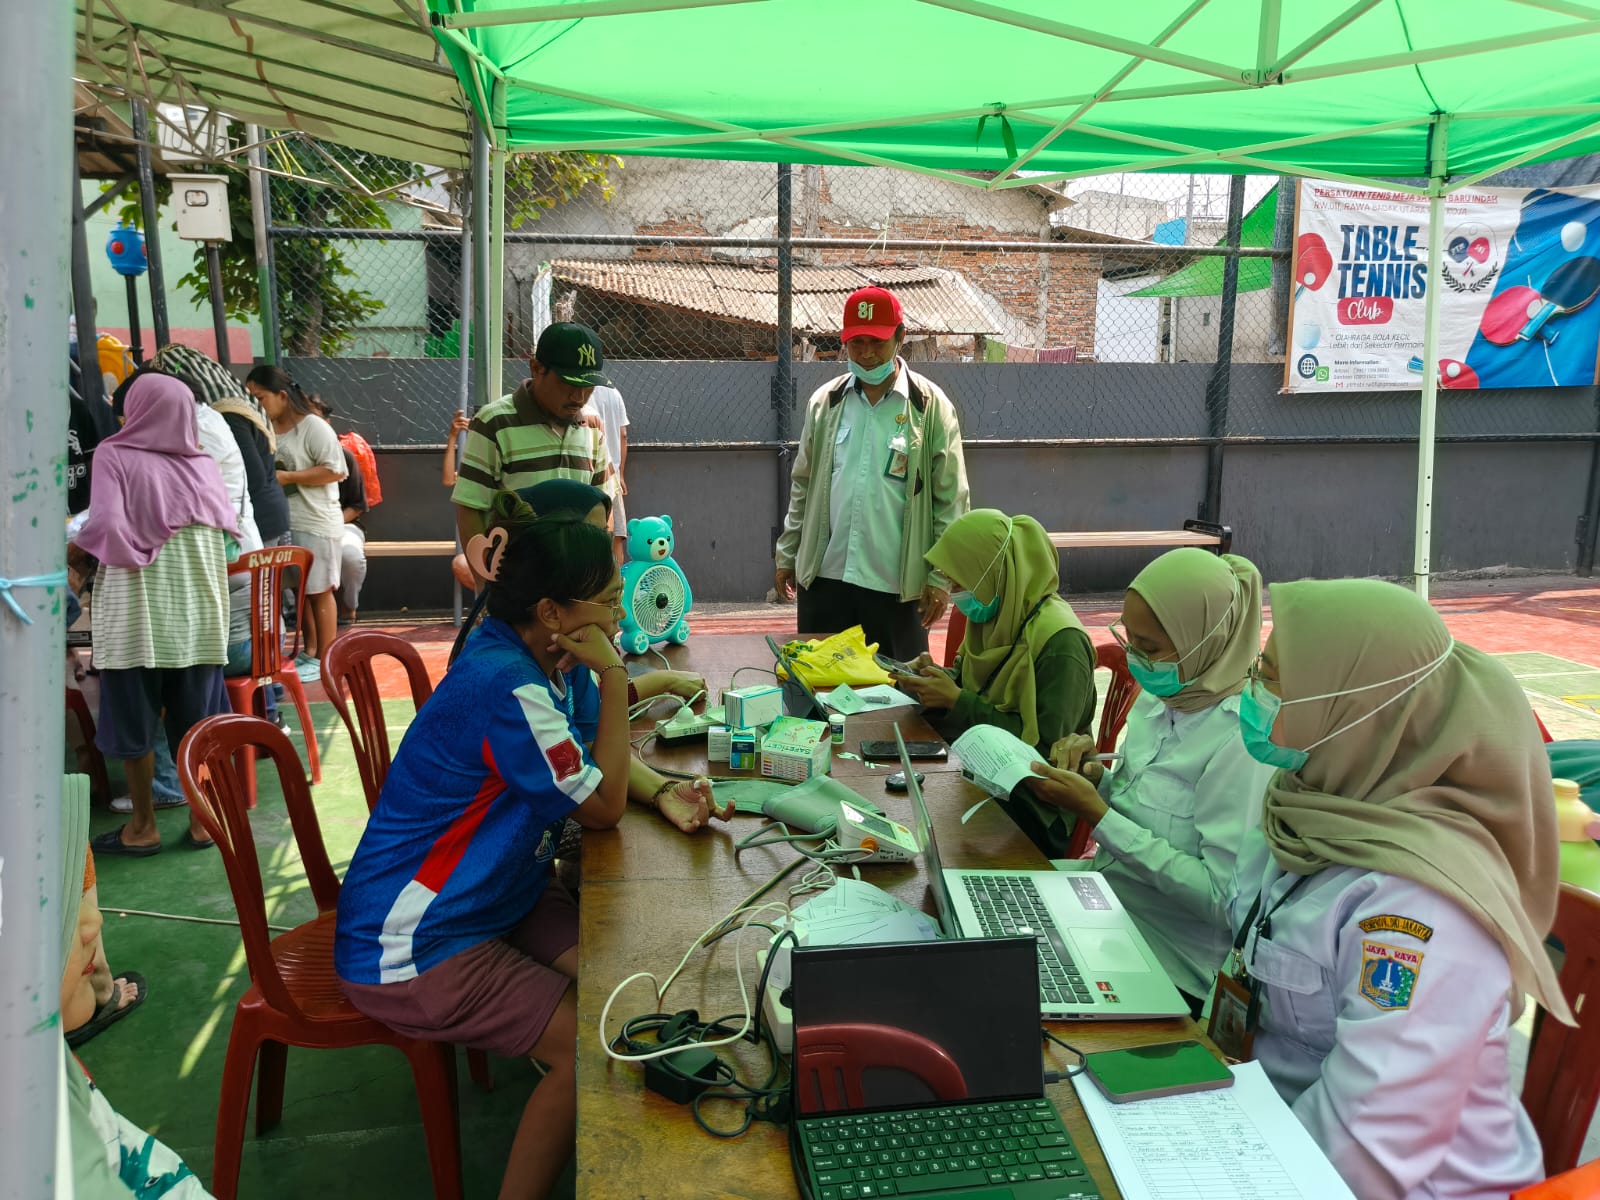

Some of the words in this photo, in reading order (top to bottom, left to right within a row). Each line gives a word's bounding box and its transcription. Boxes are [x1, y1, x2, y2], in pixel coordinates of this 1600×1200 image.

[1367, 191, 1391, 200] TENIS
[1392, 192, 1415, 201] MEJA
[1448, 194, 1470, 202] BARU
[1340, 225, 1420, 261] TABLE
[1338, 263, 1427, 299] TENNIS
[1347, 299, 1384, 320] Club
[578, 343, 597, 367] NY
[248, 550, 274, 568] RW
[276, 549, 293, 563] 011
[1366, 944, 1387, 956] JAYA
[1394, 951, 1418, 963] RAYA
